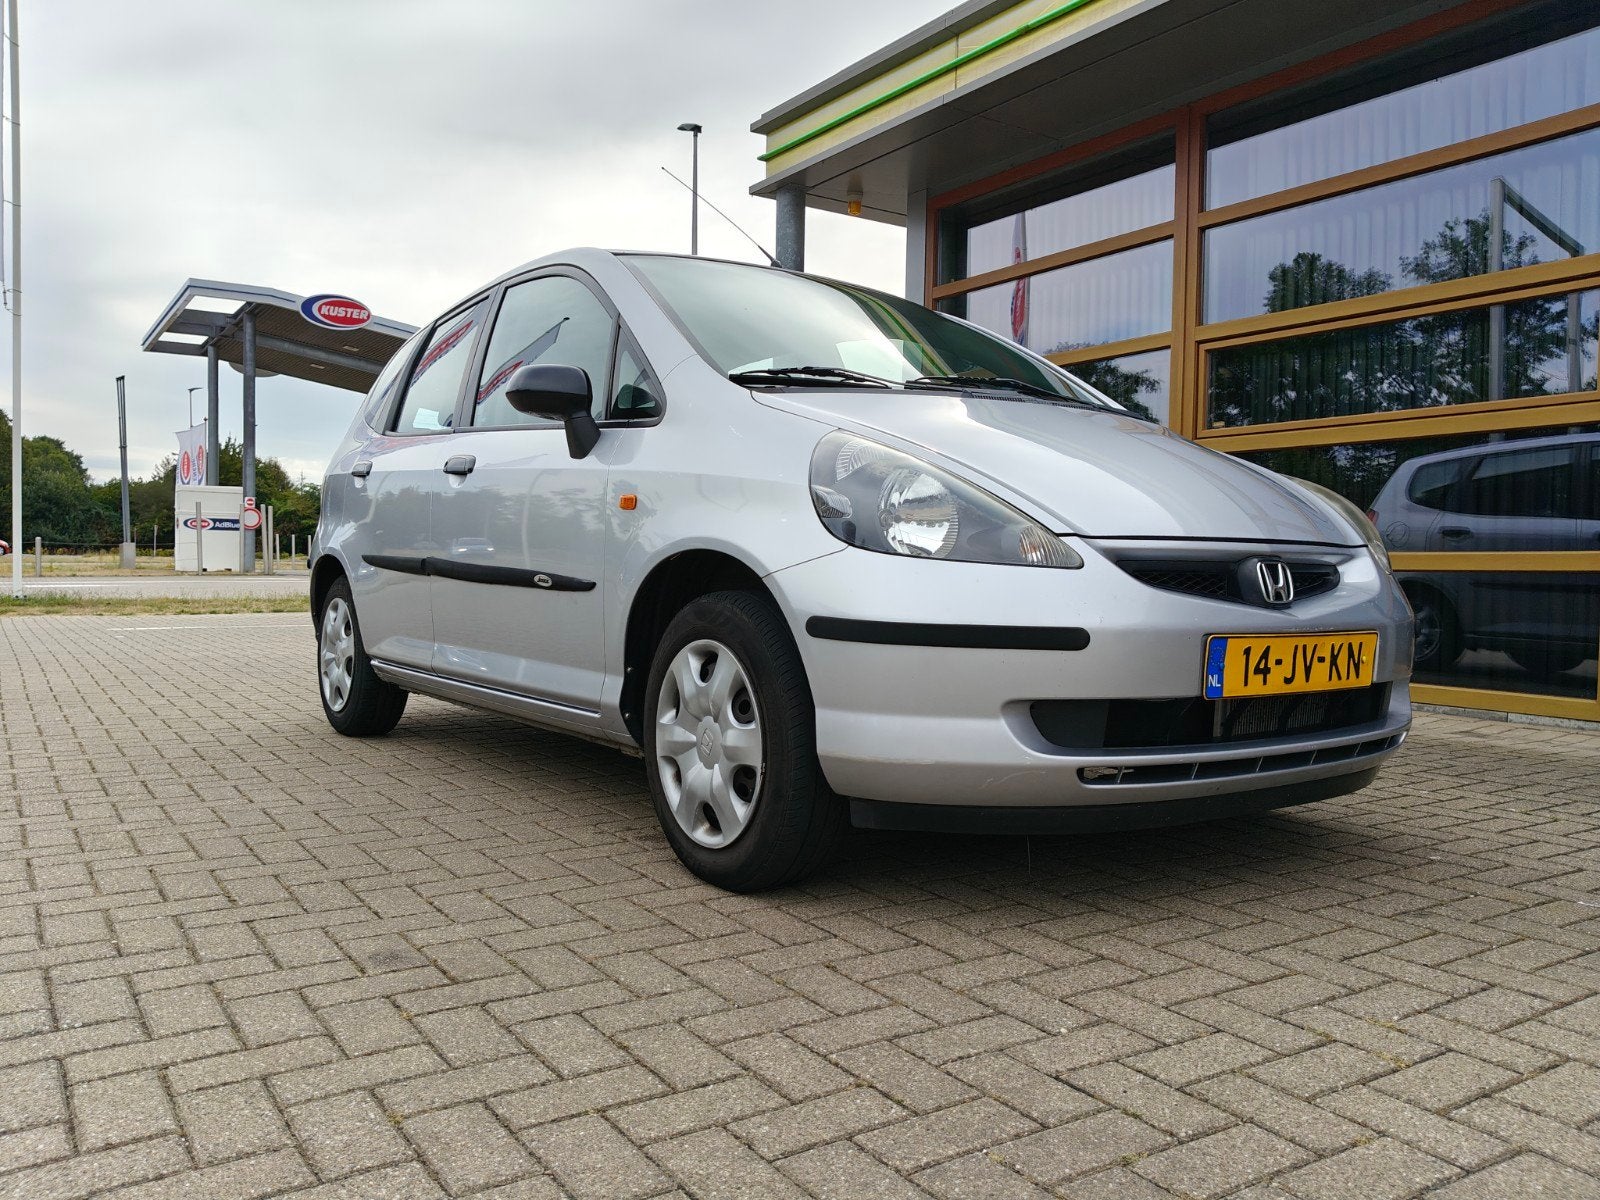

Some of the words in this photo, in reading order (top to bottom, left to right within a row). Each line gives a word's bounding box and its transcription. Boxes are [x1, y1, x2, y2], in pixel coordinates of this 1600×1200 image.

[320, 305, 369, 320] KUSTER
[1243, 641, 1363, 687] 14-JV-KN
[1208, 674, 1221, 687] NL
